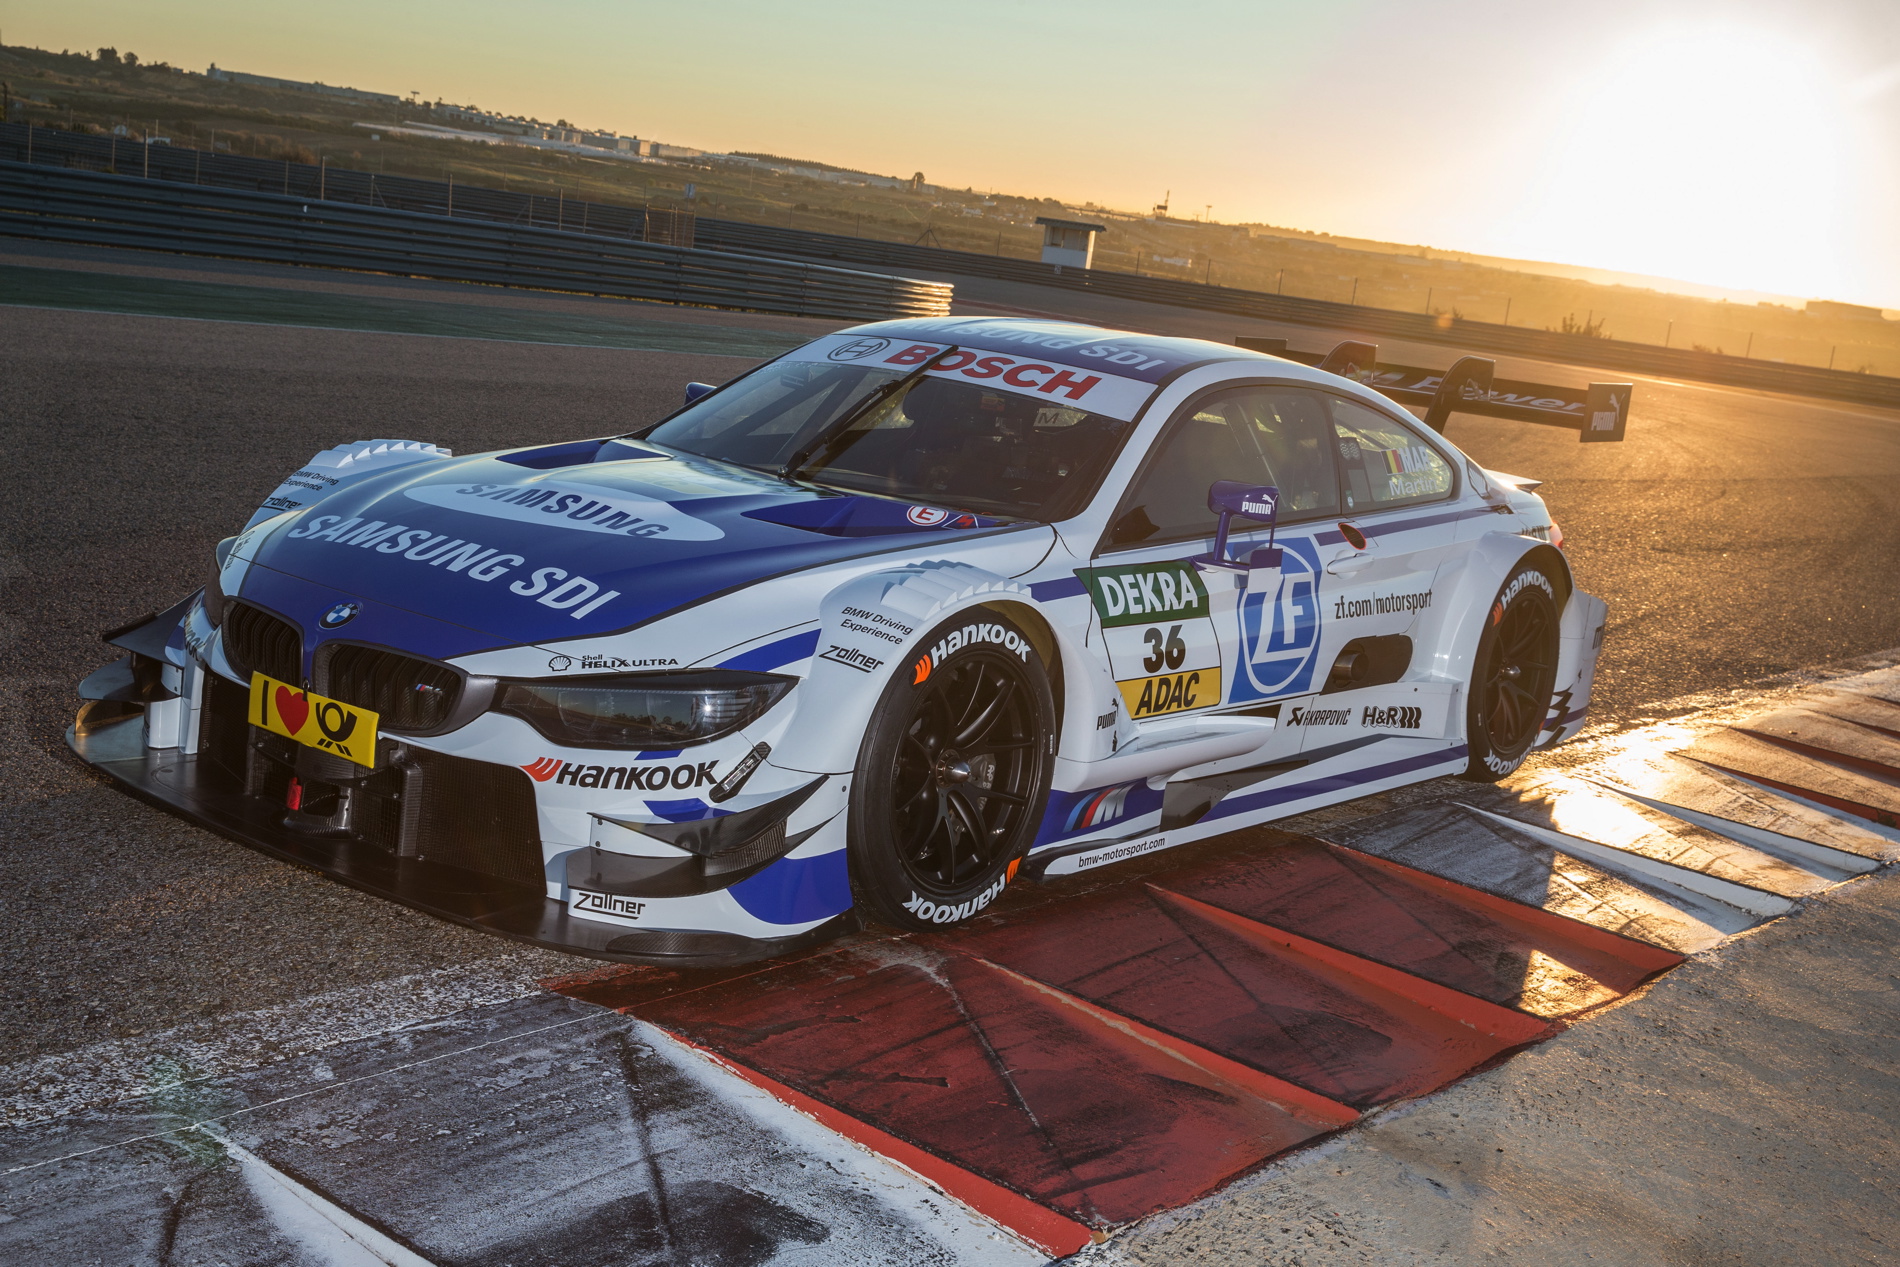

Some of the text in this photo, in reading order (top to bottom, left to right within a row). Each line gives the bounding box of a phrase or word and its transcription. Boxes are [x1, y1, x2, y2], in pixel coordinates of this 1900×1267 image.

[883, 344, 1103, 400] BOSCH
[1079, 345, 1166, 371] SDI
[1400, 446, 1432, 473] MAR
[284, 479, 323, 491] Experience
[293, 470, 339, 486] BMW Driving
[1389, 477, 1439, 496] Martin
[455, 484, 670, 537] SAMSUNG
[1241, 501, 1272, 515] PUMA
[288, 515, 525, 582] SAMSUNG
[509, 567, 621, 619] SDI
[1097, 569, 1199, 617] DEKRA
[1334, 588, 1433, 619] zf.com/motorsport
[840, 618, 903, 645] Experience
[841, 606, 914, 636] BMW Driving
[1246, 571, 1316, 665] ZF
[581, 657, 679, 669] HELIX ULTRA
[1143, 624, 1186, 674] 36
[1134, 671, 1200, 716] ADAC
[1361, 706, 1401, 728] H&R
[1078, 837, 1166, 868] bmw-motorsport.com
